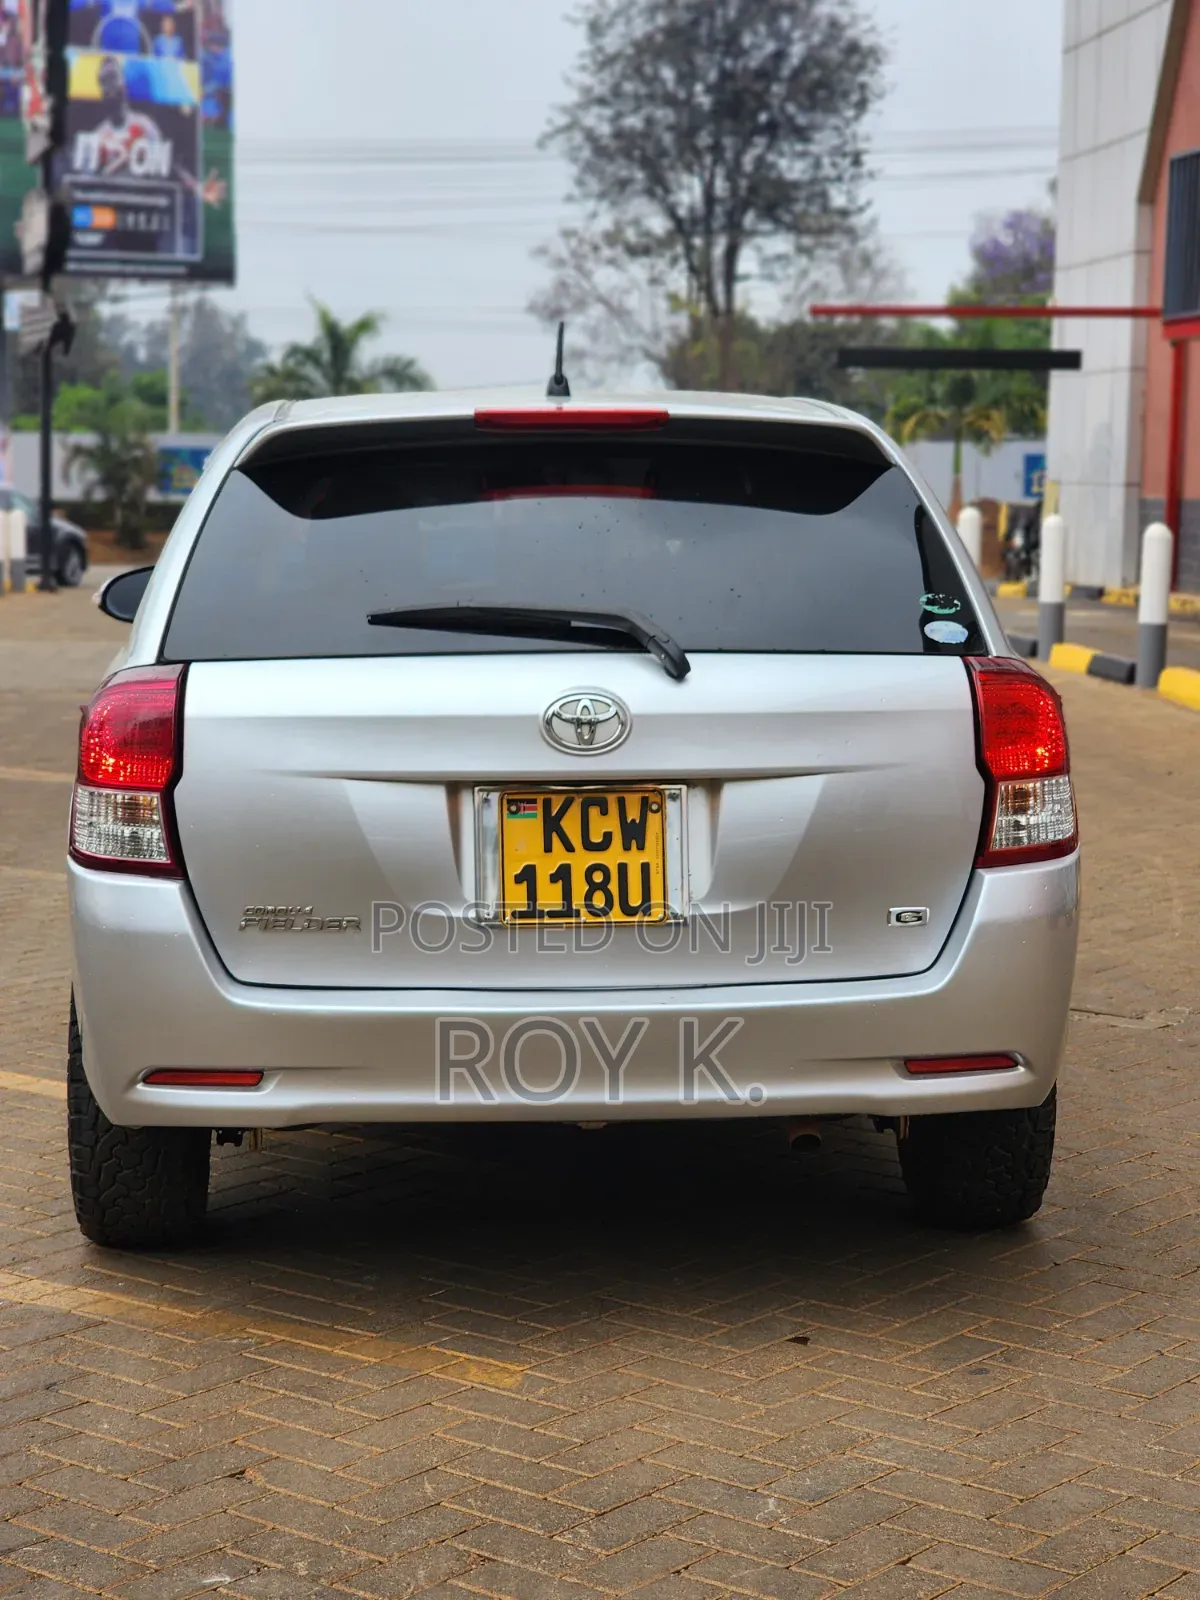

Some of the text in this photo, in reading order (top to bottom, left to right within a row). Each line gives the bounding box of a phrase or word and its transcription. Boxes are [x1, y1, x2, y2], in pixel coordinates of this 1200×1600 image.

[542, 795, 649, 853] KCW
[511, 861, 652, 919] 118U
[239, 916, 361, 931] FIELDER
